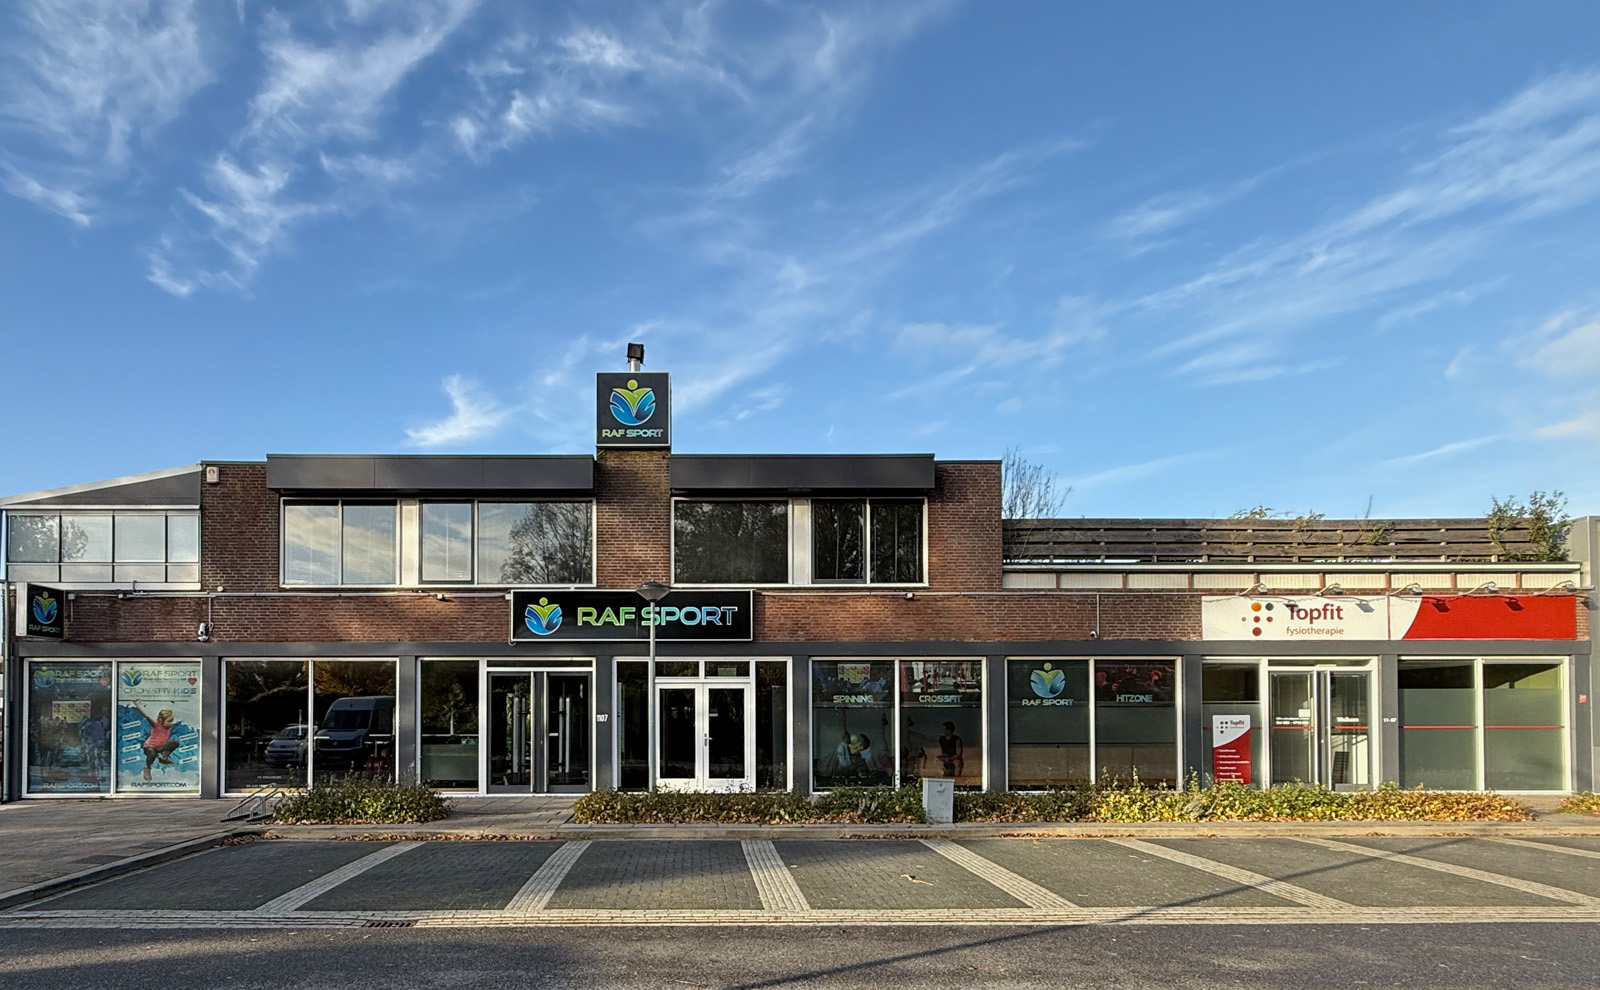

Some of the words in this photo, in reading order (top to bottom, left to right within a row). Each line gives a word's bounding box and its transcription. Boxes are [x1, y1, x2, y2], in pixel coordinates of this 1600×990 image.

[602, 429, 625, 438] RAF
[626, 429, 663, 438] SPORT
[577, 606, 636, 626] RAF
[641, 606, 738, 626] SPORT
[1287, 603, 1344, 624] Topfit
[1286, 626, 1344, 637] fysiotherapie
[55, 670, 75, 678] RAF
[76, 670, 109, 678] SPORT
[833, 695, 873, 703] SPINNING
[919, 695, 962, 703] CROSSFIT
[1022, 698, 1041, 706] RAF
[1042, 698, 1074, 706] SPORT
[1116, 694, 1153, 703] HITZONE
